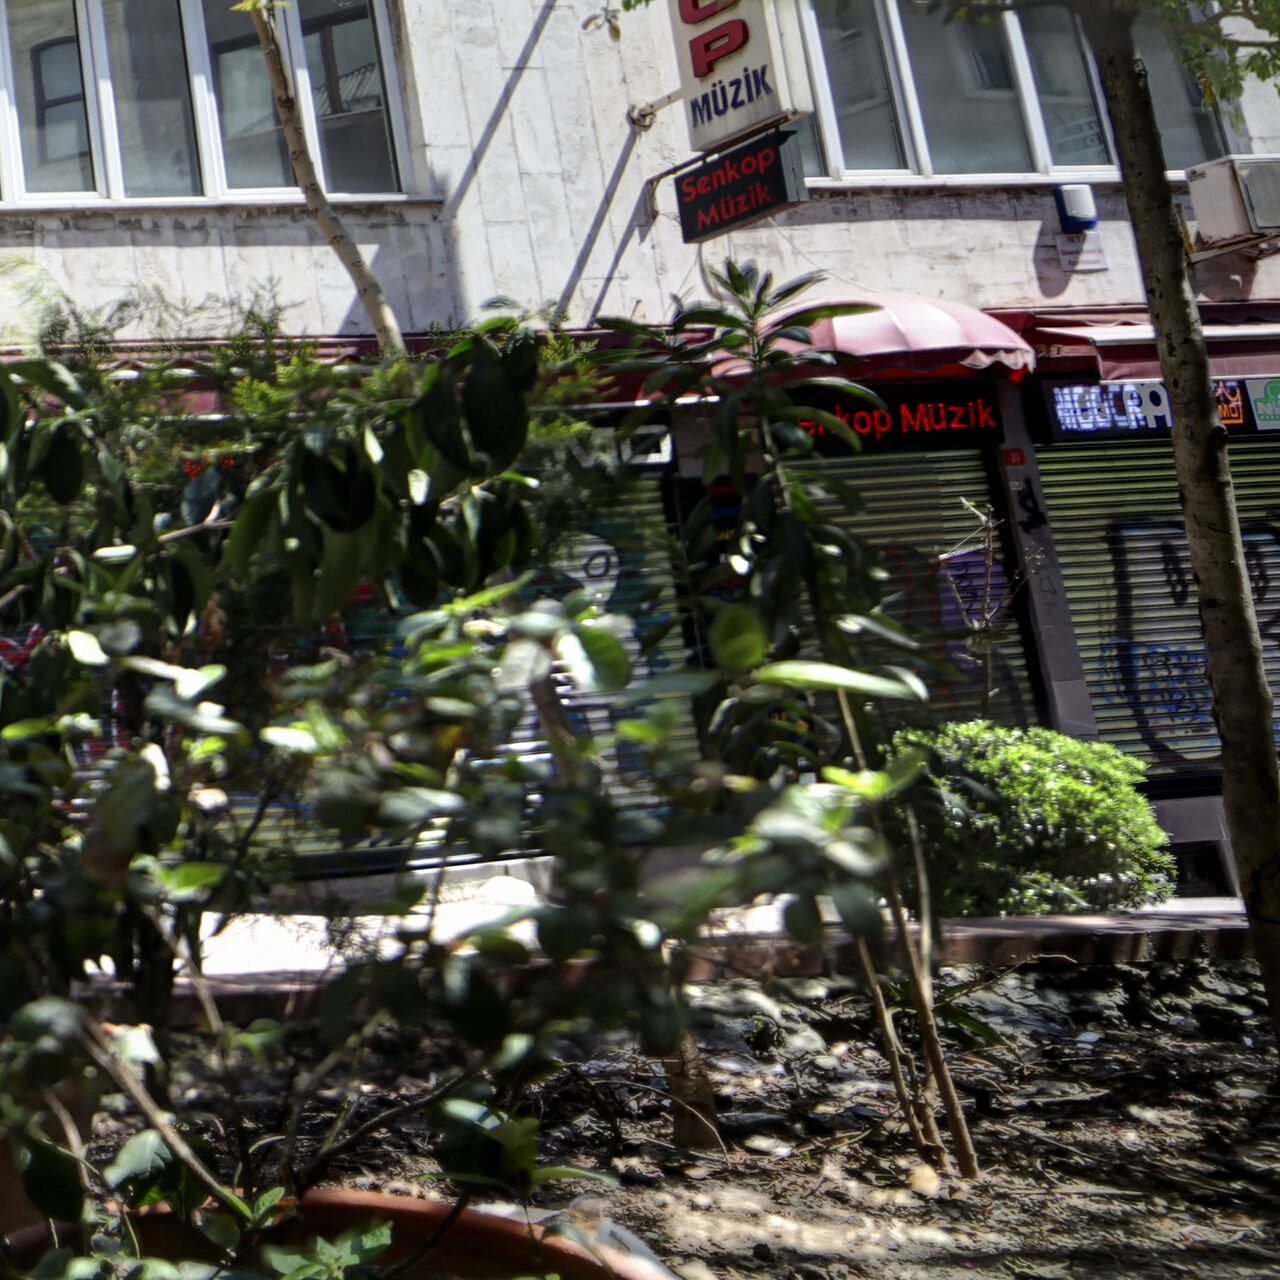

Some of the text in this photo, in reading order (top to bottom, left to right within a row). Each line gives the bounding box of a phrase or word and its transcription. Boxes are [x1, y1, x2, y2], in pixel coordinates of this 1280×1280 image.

[690, 65, 773, 128] MÜZİK
[681, 146, 777, 204] Senkop
[695, 181, 772, 231] Müzik
[899, 399, 997, 433] Müzik
